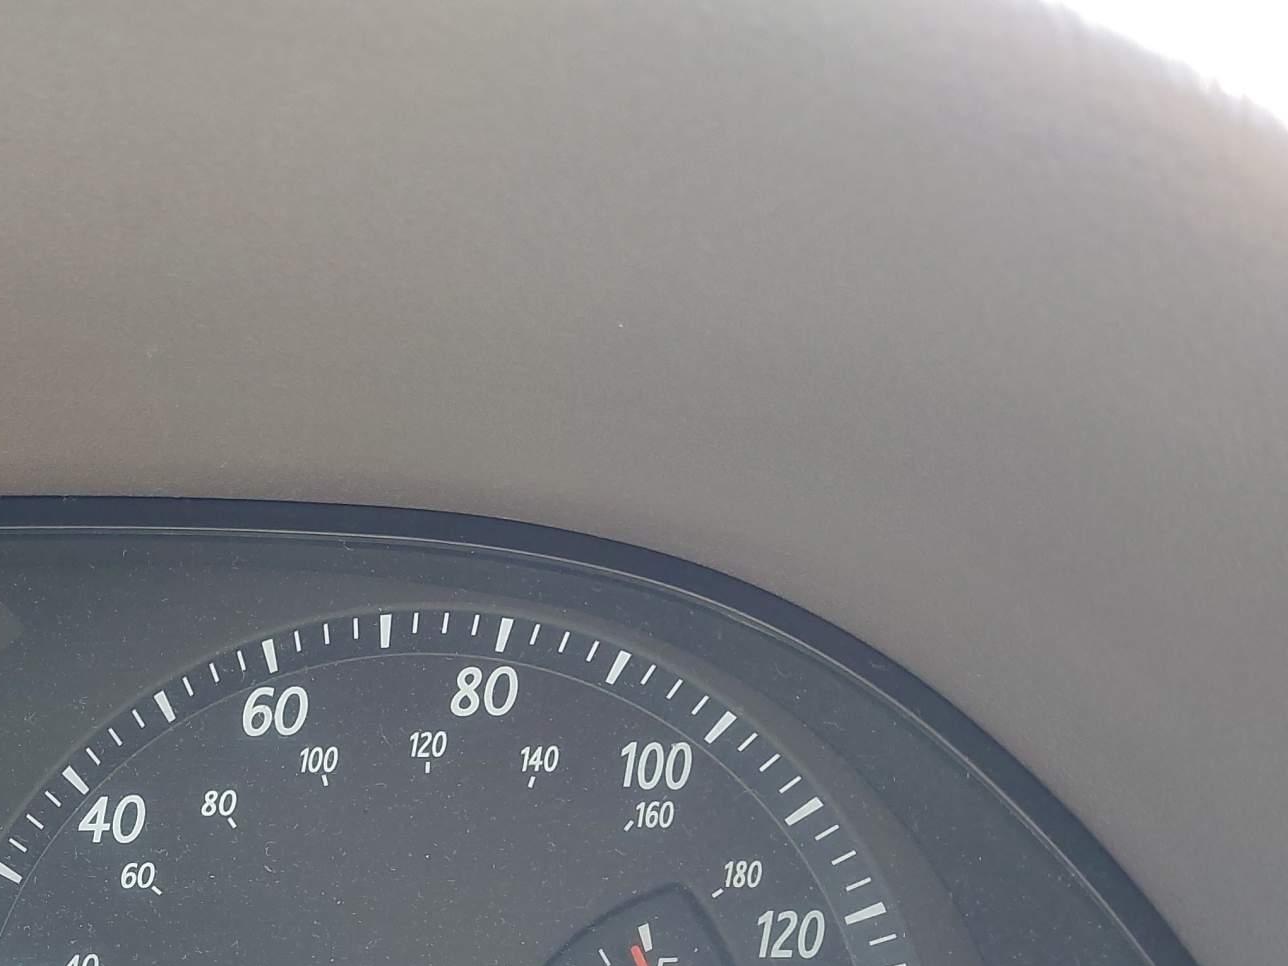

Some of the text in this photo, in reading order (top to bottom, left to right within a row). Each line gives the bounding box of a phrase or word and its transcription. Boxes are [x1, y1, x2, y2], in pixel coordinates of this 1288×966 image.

[450, 666, 518, 716] 80
[242, 687, 308, 736] 60
[410, 731, 447, 757] 120
[299, 746, 338, 772] 100
[520, 746, 559, 773] 140
[620, 742, 692, 790] 100
[201, 790, 236, 816] 80
[636, 801, 674, 828] 160
[78, 795, 146, 843] 40
[120, 862, 155, 889] 60
[723, 861, 762, 888] 180
[757, 910, 825, 959] 120
